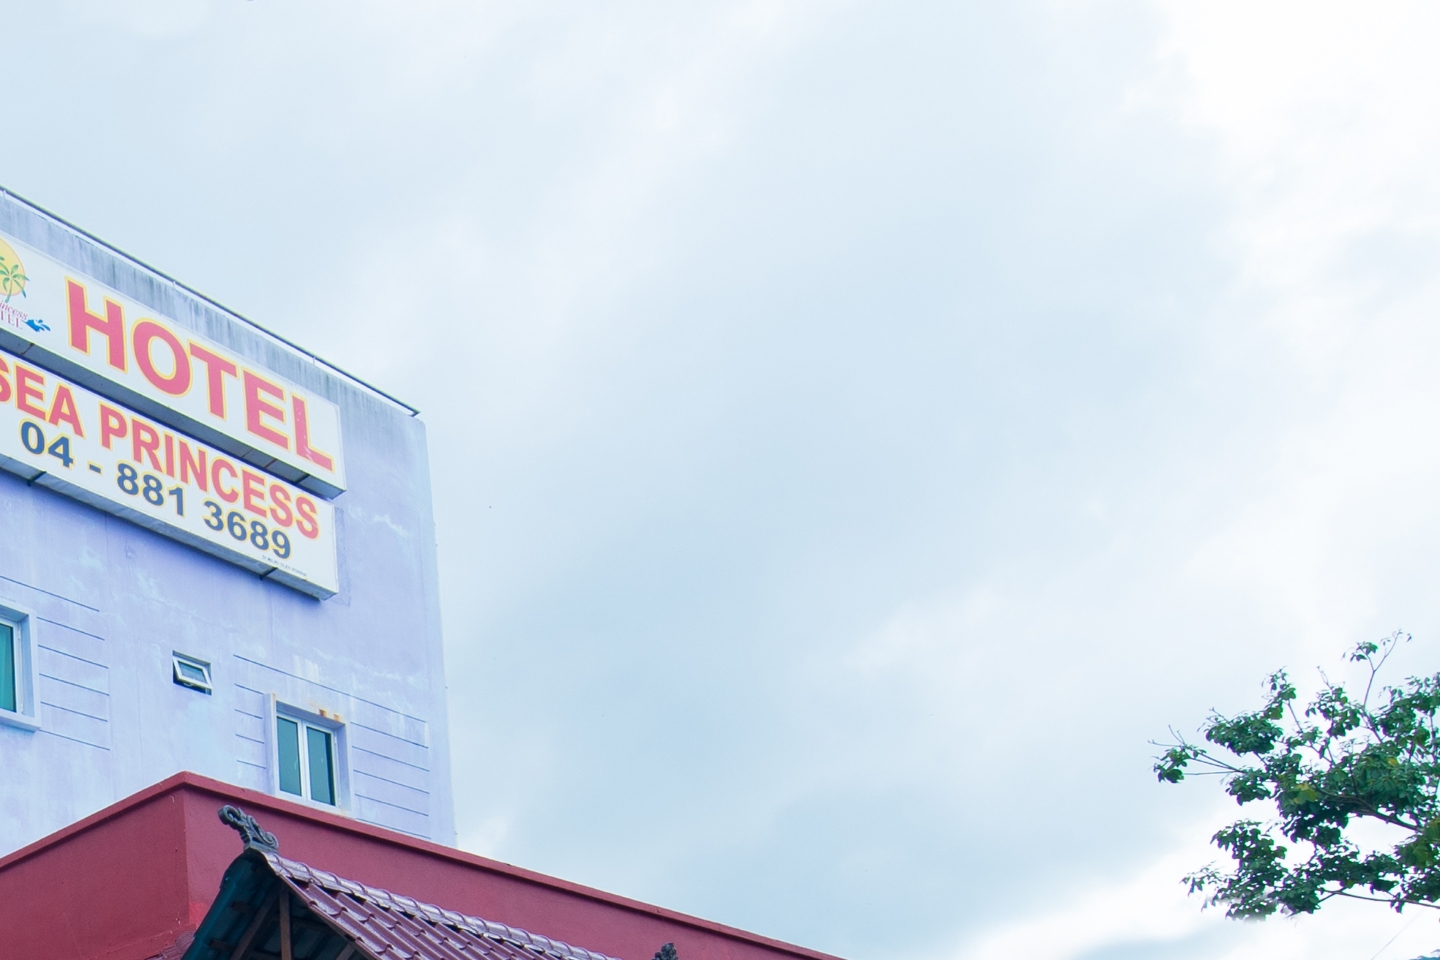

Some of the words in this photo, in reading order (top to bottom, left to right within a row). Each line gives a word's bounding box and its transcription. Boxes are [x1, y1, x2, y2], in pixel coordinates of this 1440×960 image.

[65, 276, 335, 473] HOTEL
[21, 421, 74, 469] 04
[117, 463, 185, 517] 881
[203, 500, 292, 560] 3689
[99, 402, 320, 539] PRINCESS
